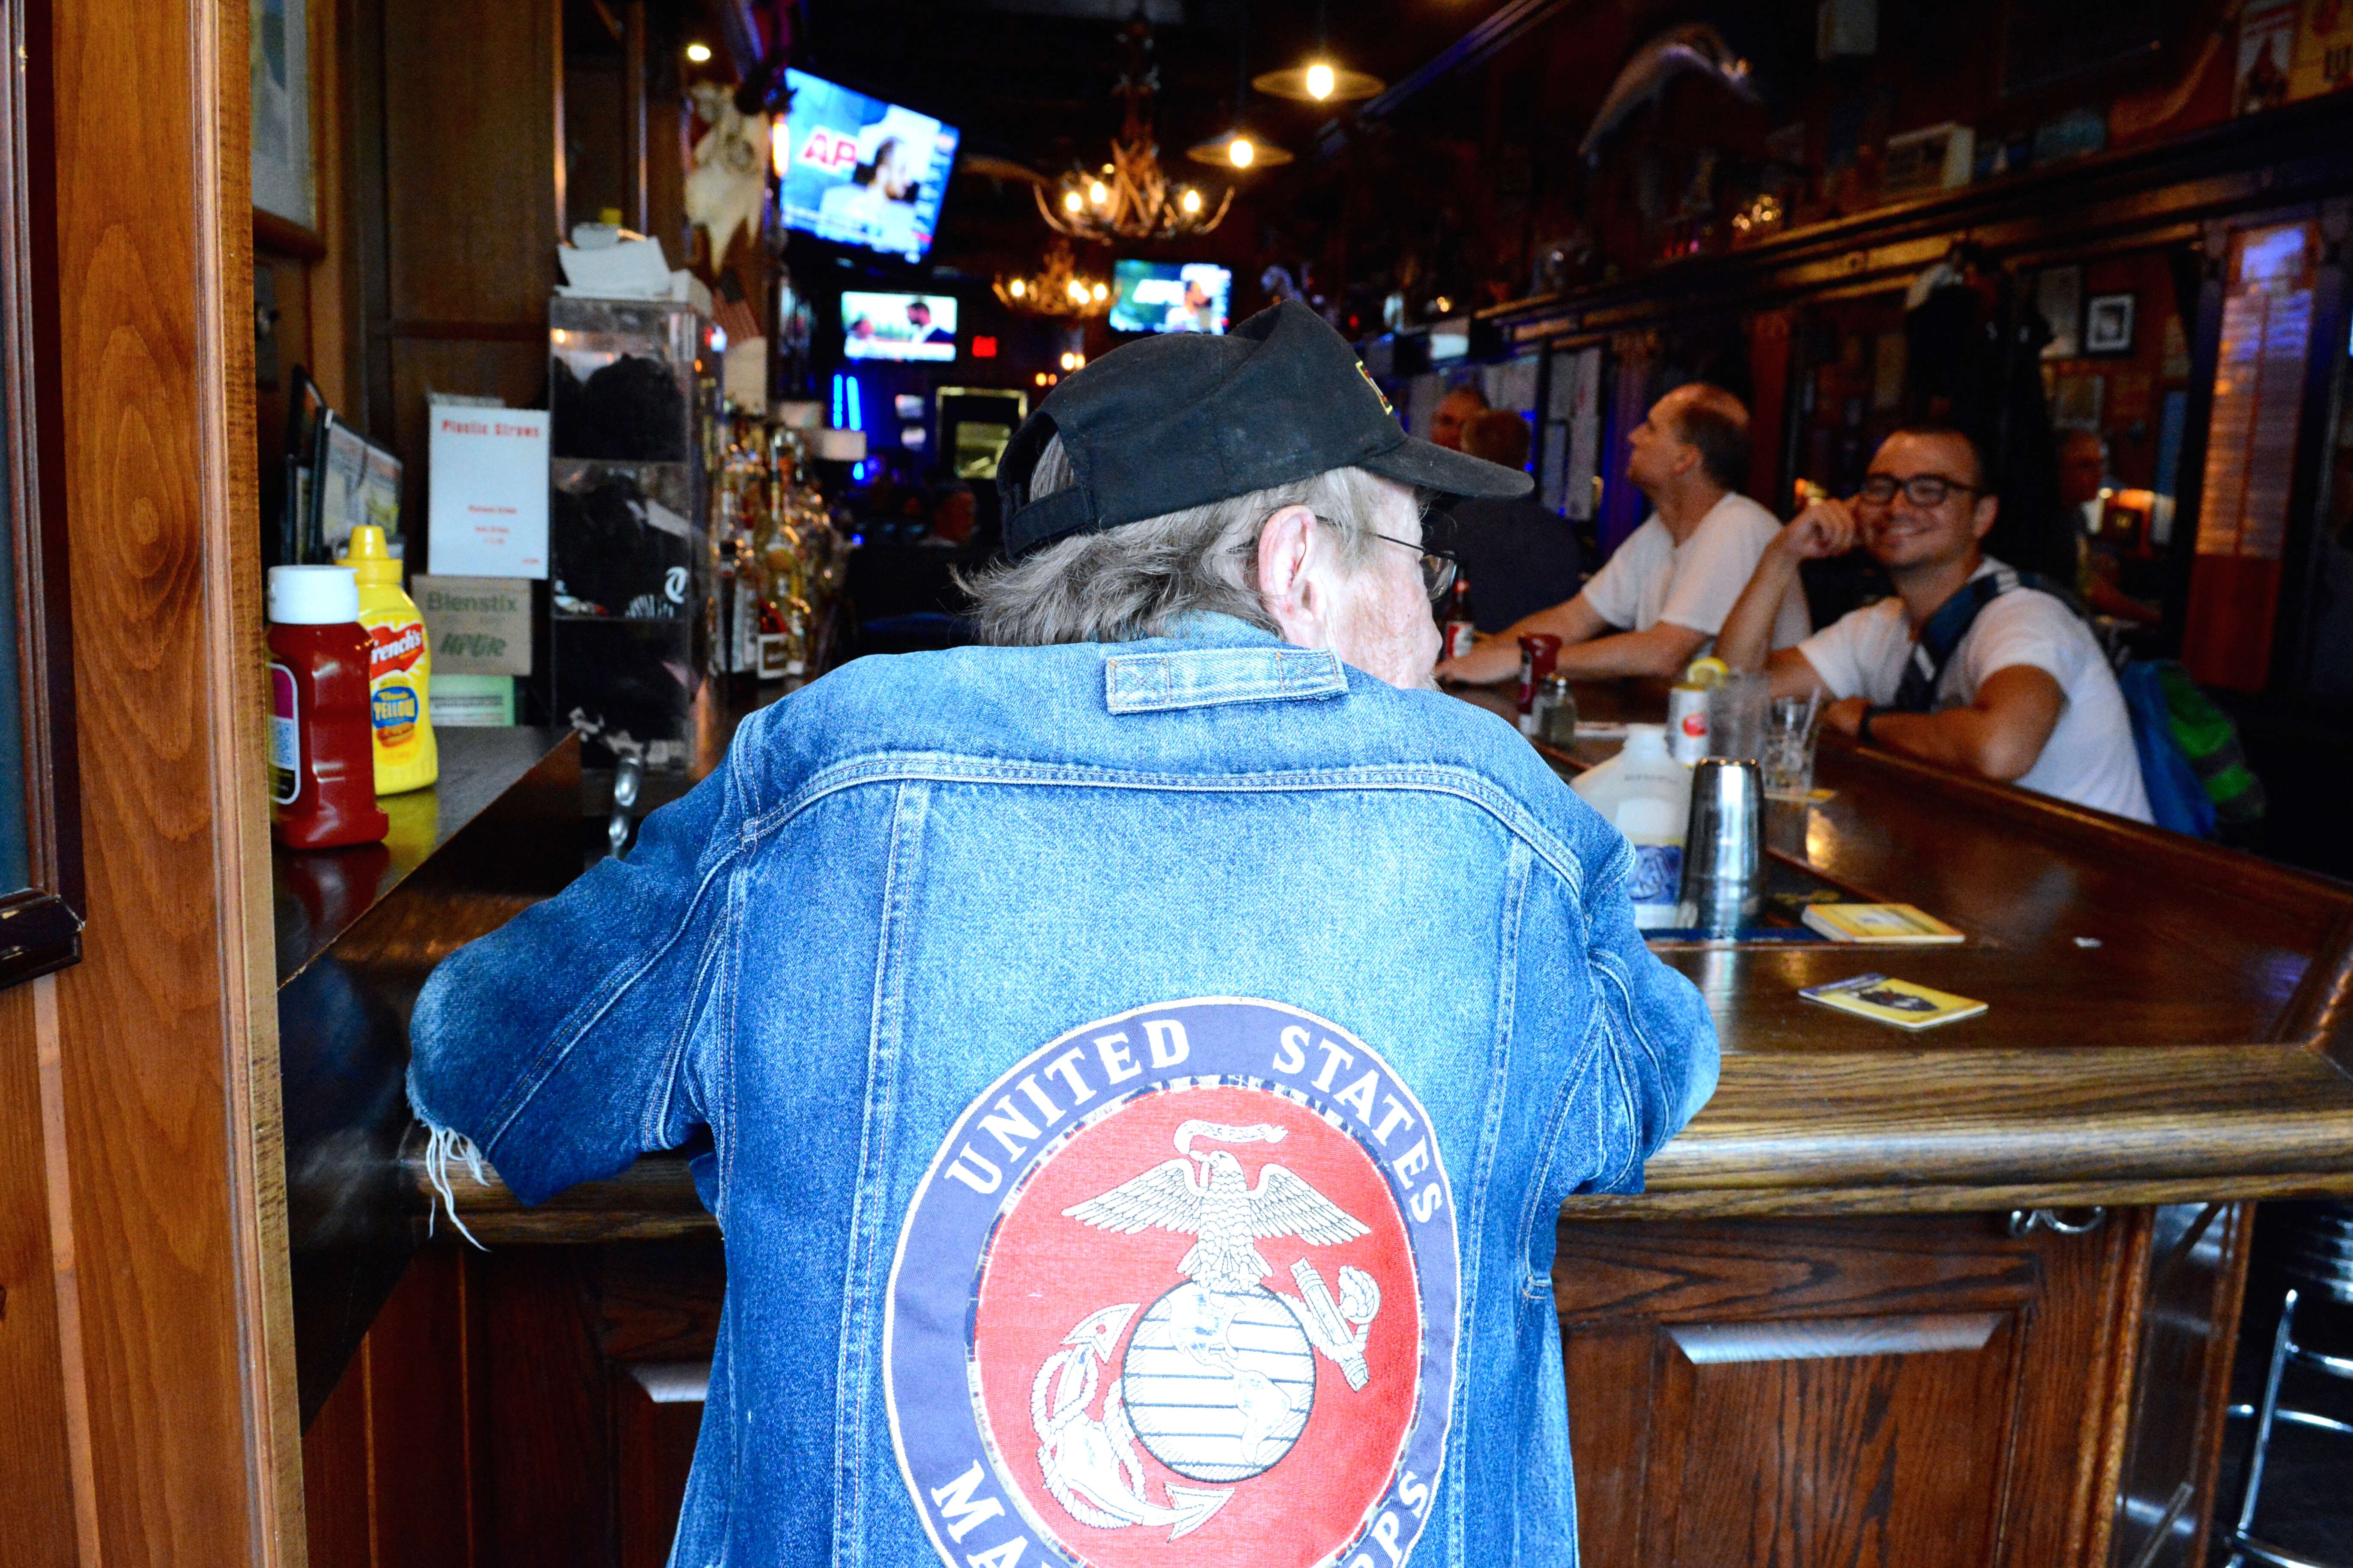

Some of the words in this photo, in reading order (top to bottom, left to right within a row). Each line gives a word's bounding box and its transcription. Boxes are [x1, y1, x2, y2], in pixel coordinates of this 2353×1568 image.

[371, 629, 422, 665] rench's
[373, 698, 415, 721] YELLOW
[944, 1018, 1190, 1195] UNITED
[1272, 1025, 1442, 1224] STATES
